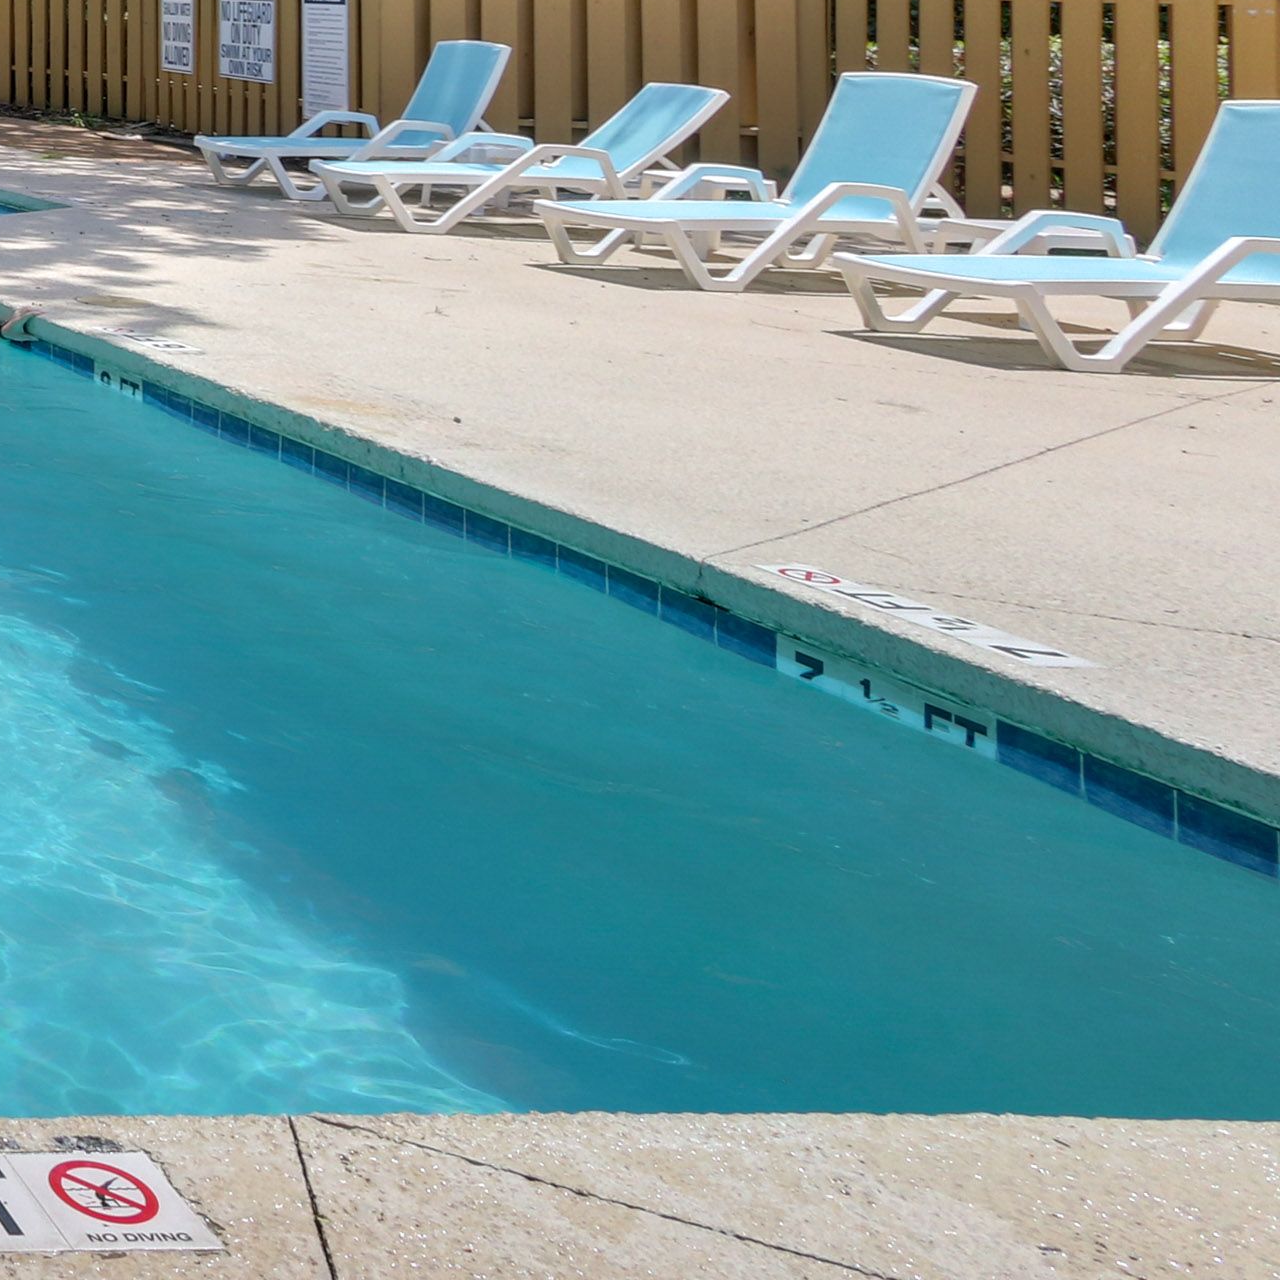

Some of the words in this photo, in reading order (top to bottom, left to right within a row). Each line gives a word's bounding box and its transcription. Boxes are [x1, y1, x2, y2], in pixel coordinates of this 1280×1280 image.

[221, 1, 231, 22] NO
[233, 1, 272, 25] LIFEGUARD
[163, 21, 171, 41] NO
[172, 22, 191, 43] DIVING
[231, 23, 241, 44] ON
[243, 23, 261, 46] DUTY
[164, 45, 190, 67] ALLOWED
[221, 43, 240, 60] SWIM
[242, 45, 250, 61] AT
[252, 47, 272, 64] YOUR
[228, 60, 245, 75] OWN
[246, 62, 264, 78] RISK
[794, 650, 824, 681] 7
[86, 1232, 117, 1244] NO
[126, 1231, 194, 1243] DIVING
